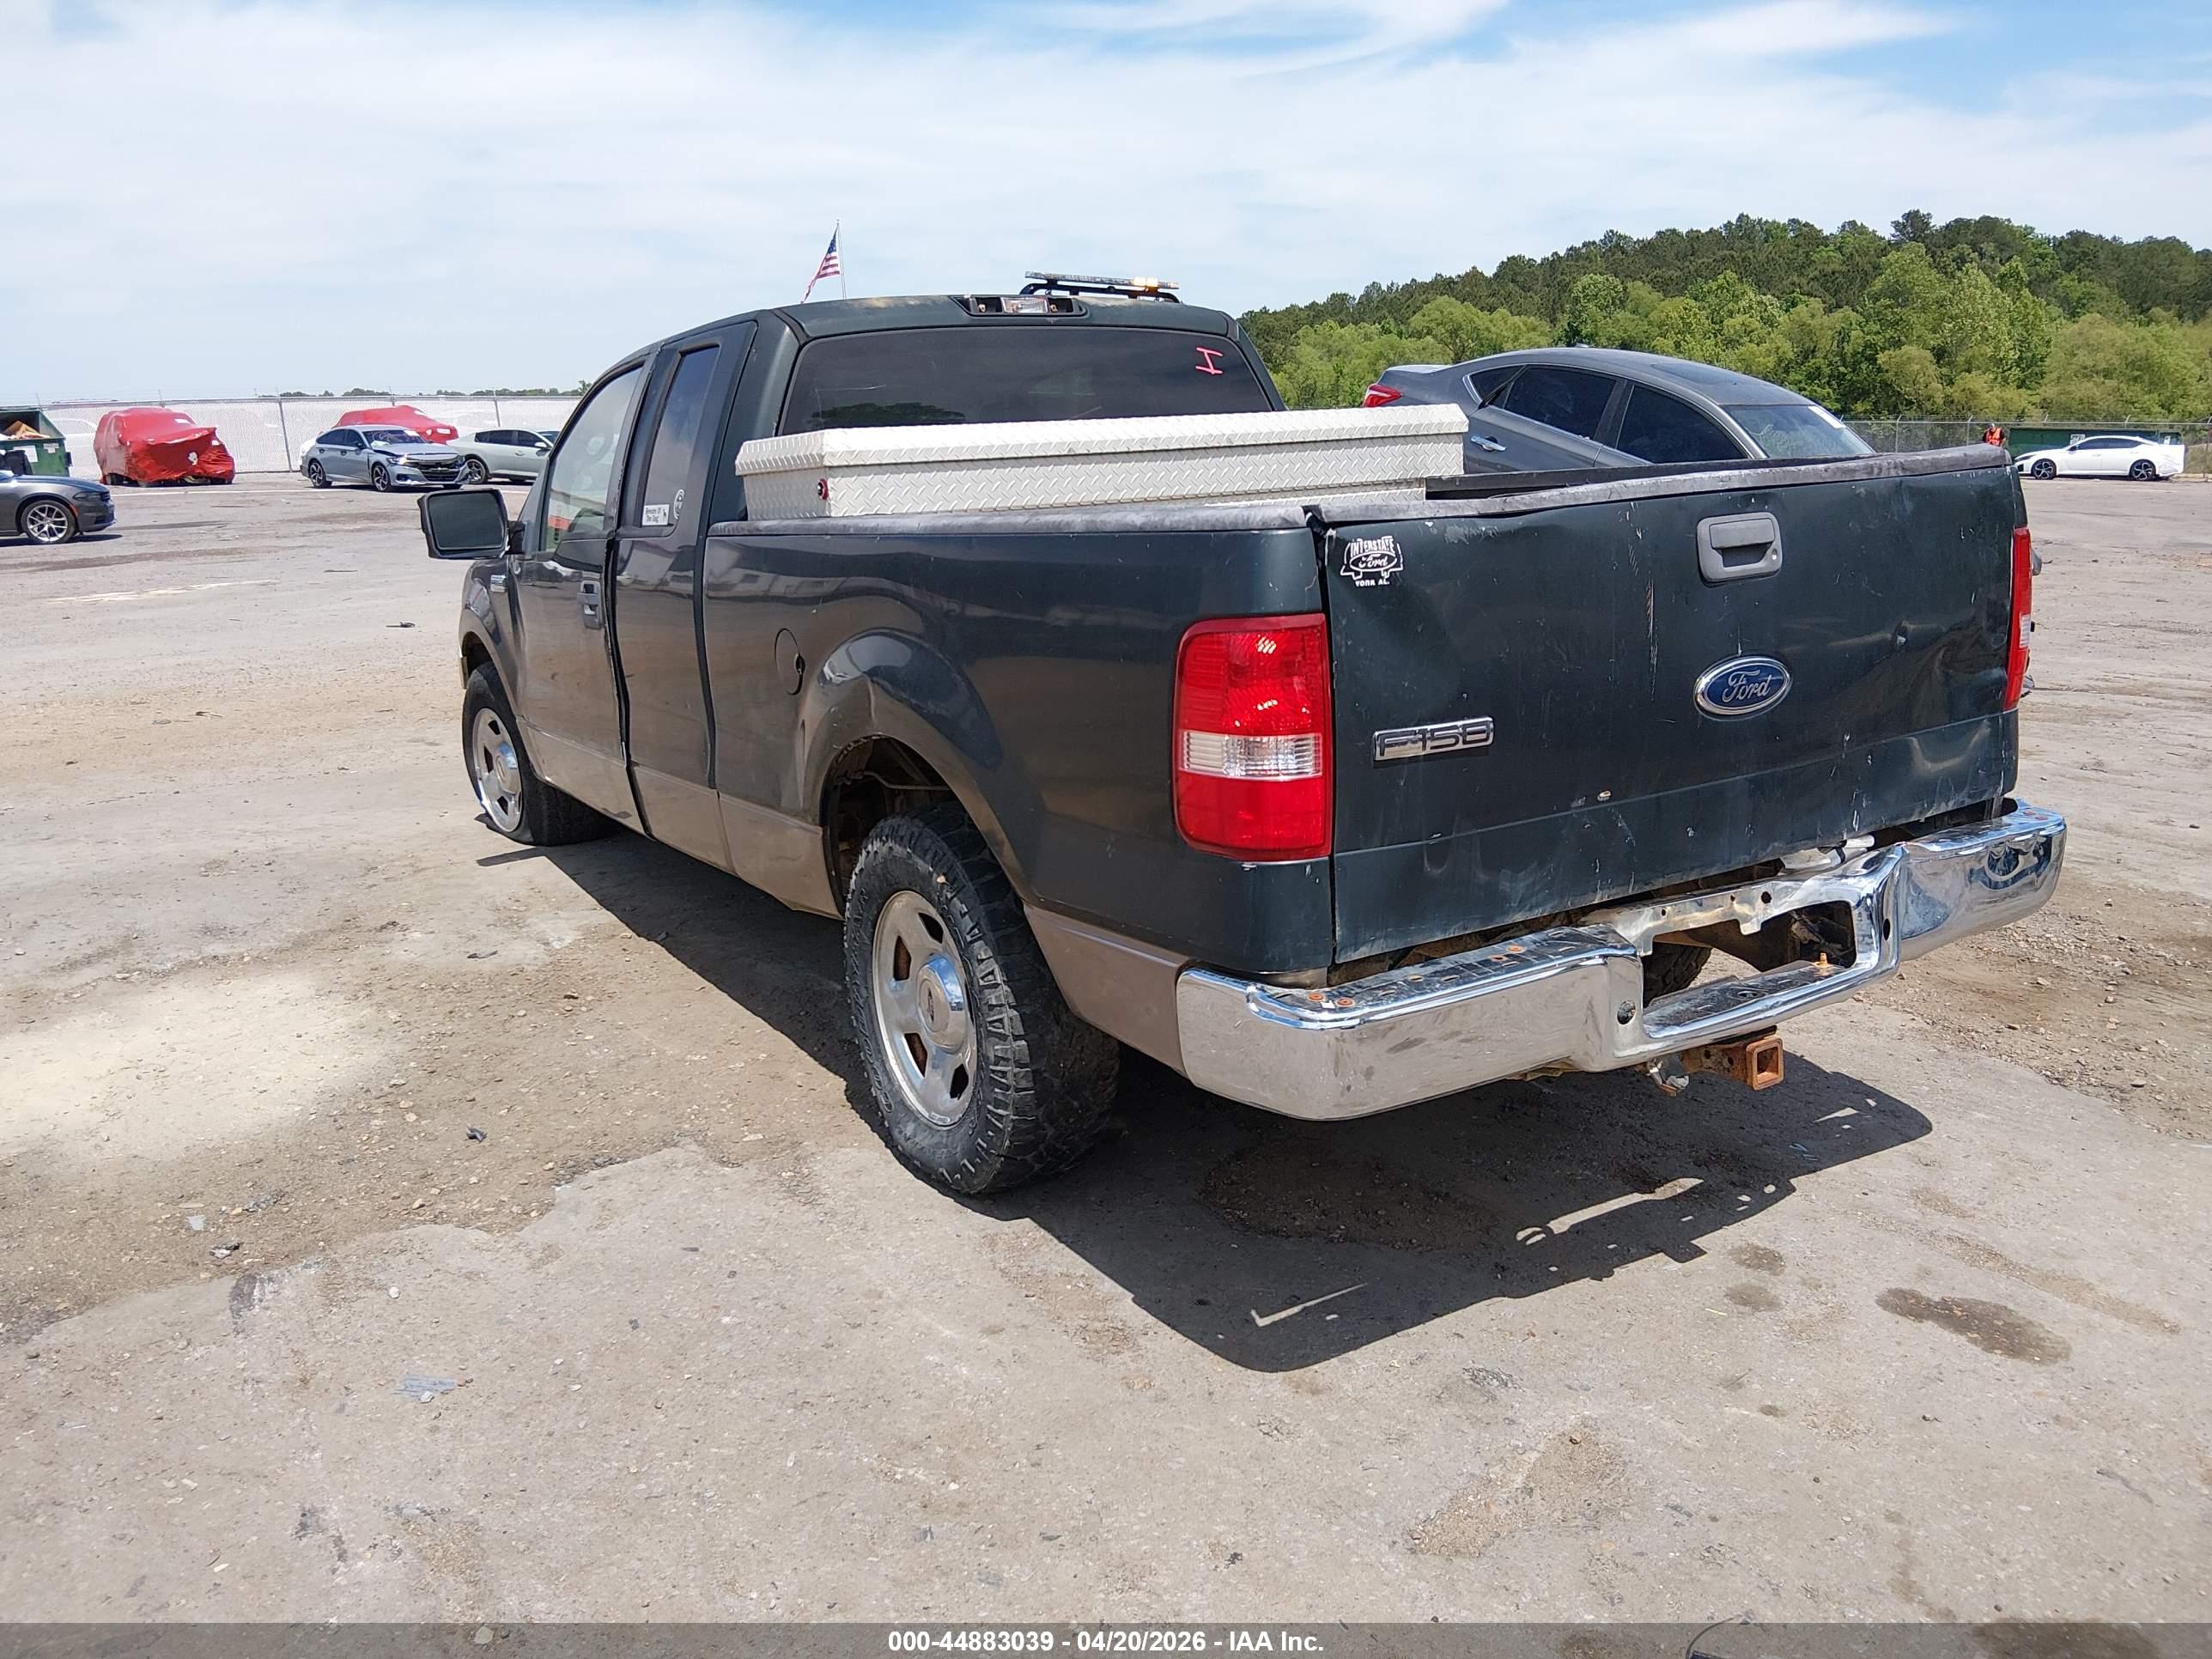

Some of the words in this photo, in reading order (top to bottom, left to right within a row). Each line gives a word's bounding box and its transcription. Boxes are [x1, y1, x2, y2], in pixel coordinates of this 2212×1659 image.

[1358, 554, 1389, 568] Ford
[1722, 670, 1772, 702] Ford
[1376, 719, 1492, 757] F-150
